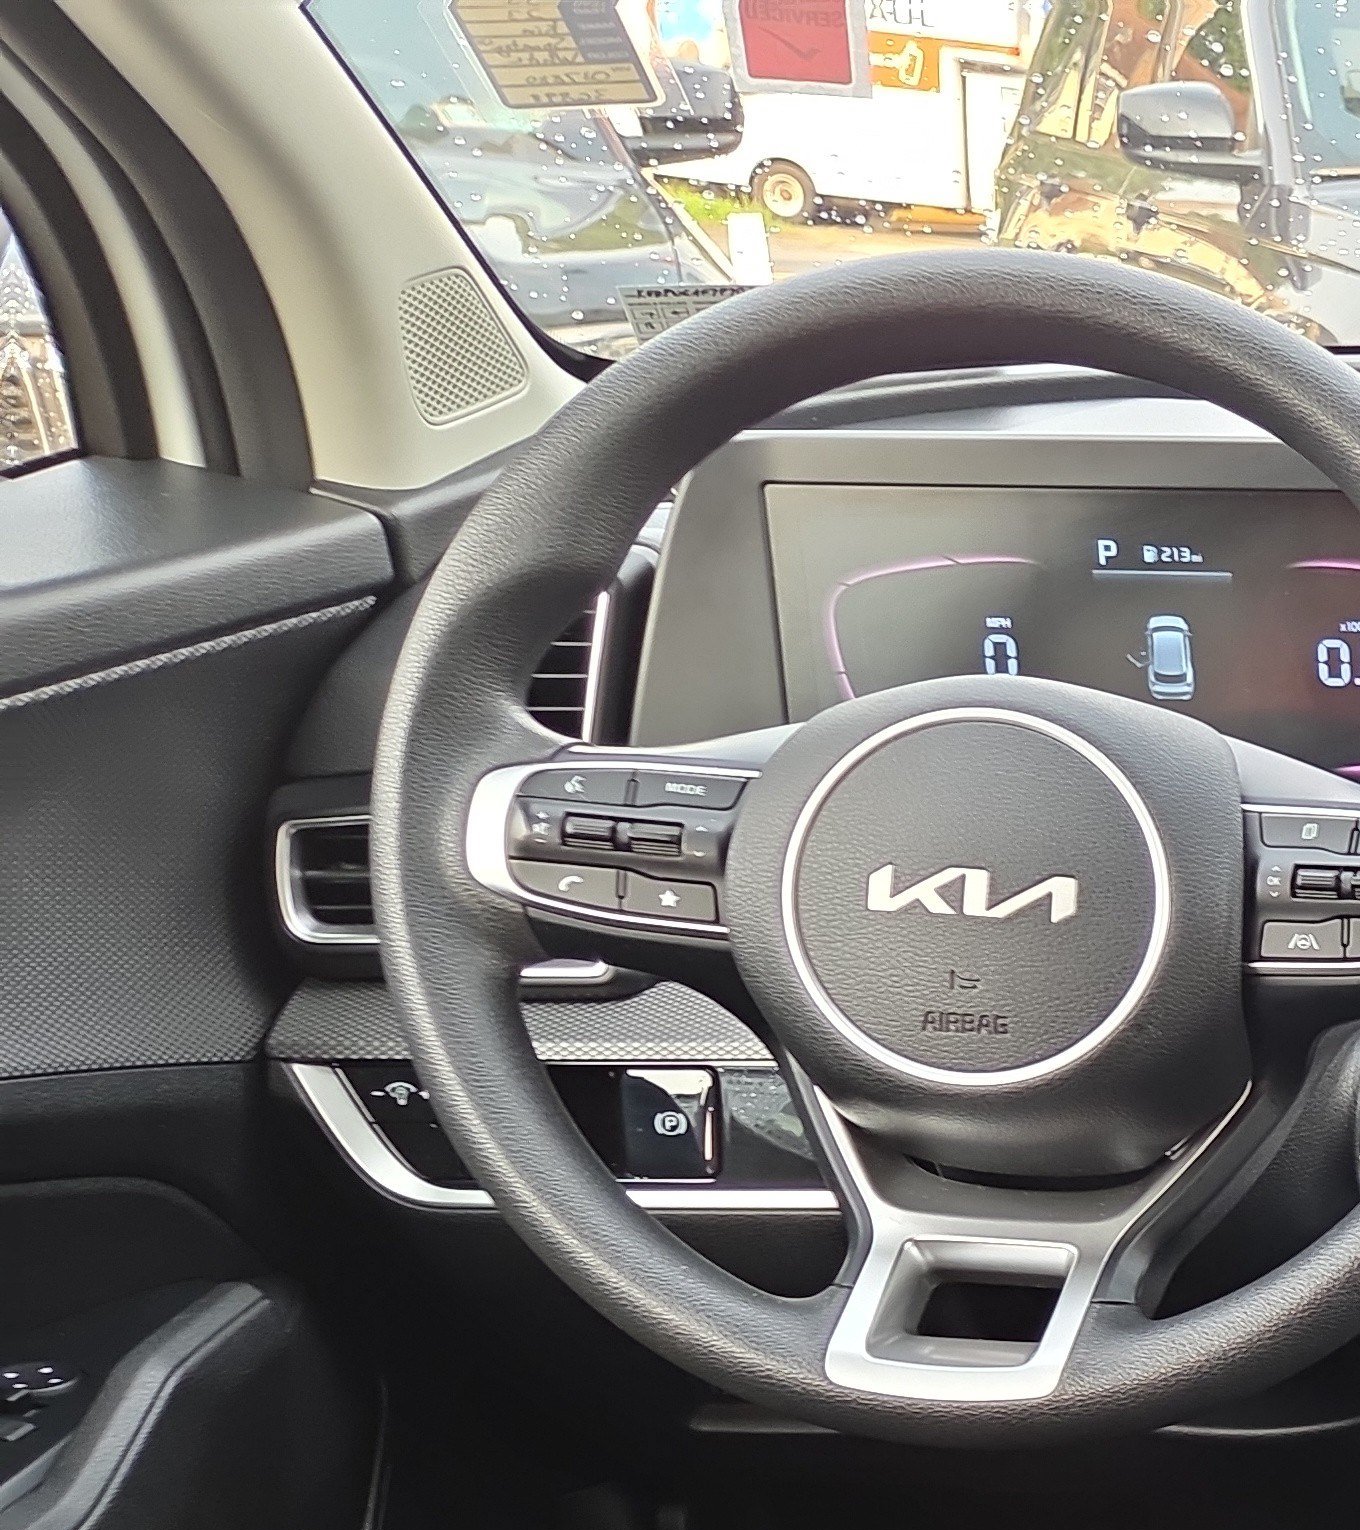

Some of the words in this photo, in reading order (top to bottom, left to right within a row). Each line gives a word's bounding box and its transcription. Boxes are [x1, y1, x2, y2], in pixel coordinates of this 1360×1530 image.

[1097, 538, 1118, 566] P
[867, 863, 1078, 924] KIA
[921, 1010, 1009, 1035] AIRBAG
